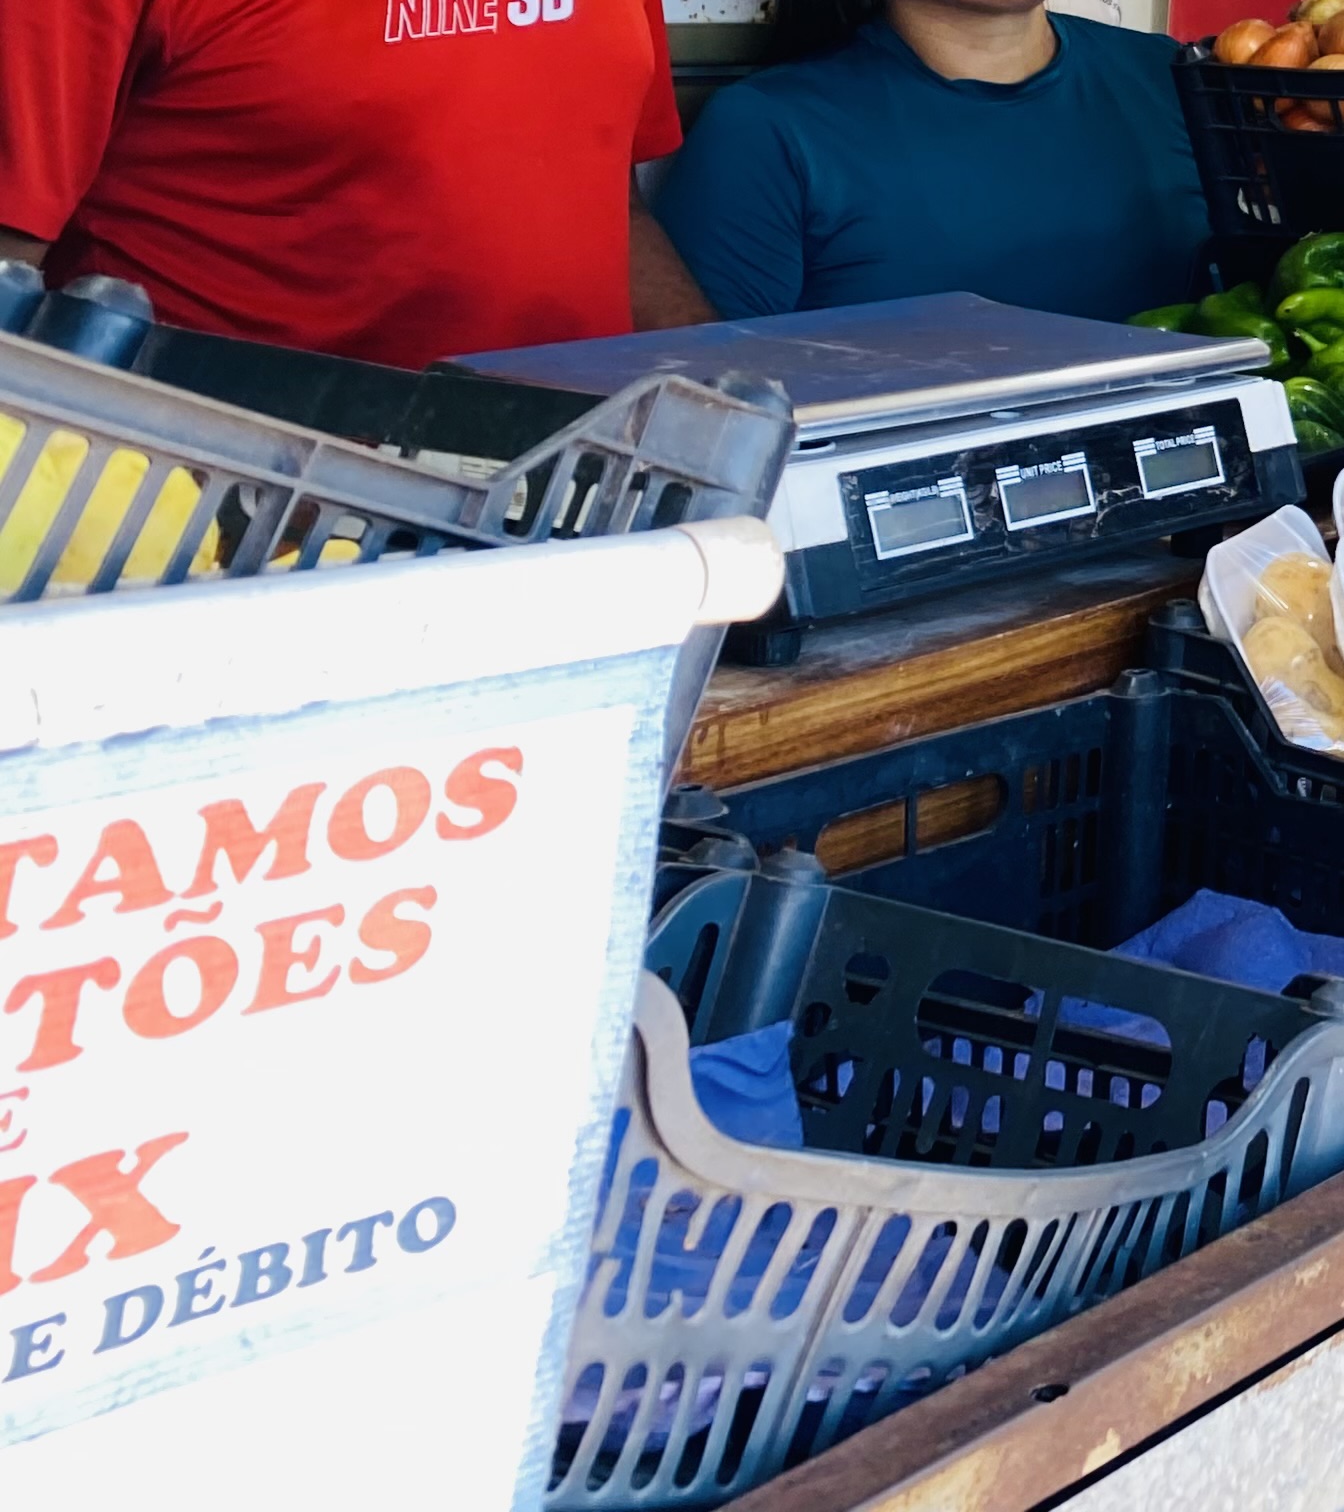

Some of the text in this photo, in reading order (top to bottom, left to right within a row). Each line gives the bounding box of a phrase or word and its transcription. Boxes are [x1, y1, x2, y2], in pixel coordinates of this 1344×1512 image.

[1039, 460, 1063, 476] PRICE
[3, 884, 438, 1073] TÕES
[2, 1195, 457, 1383] E DÉBITO
